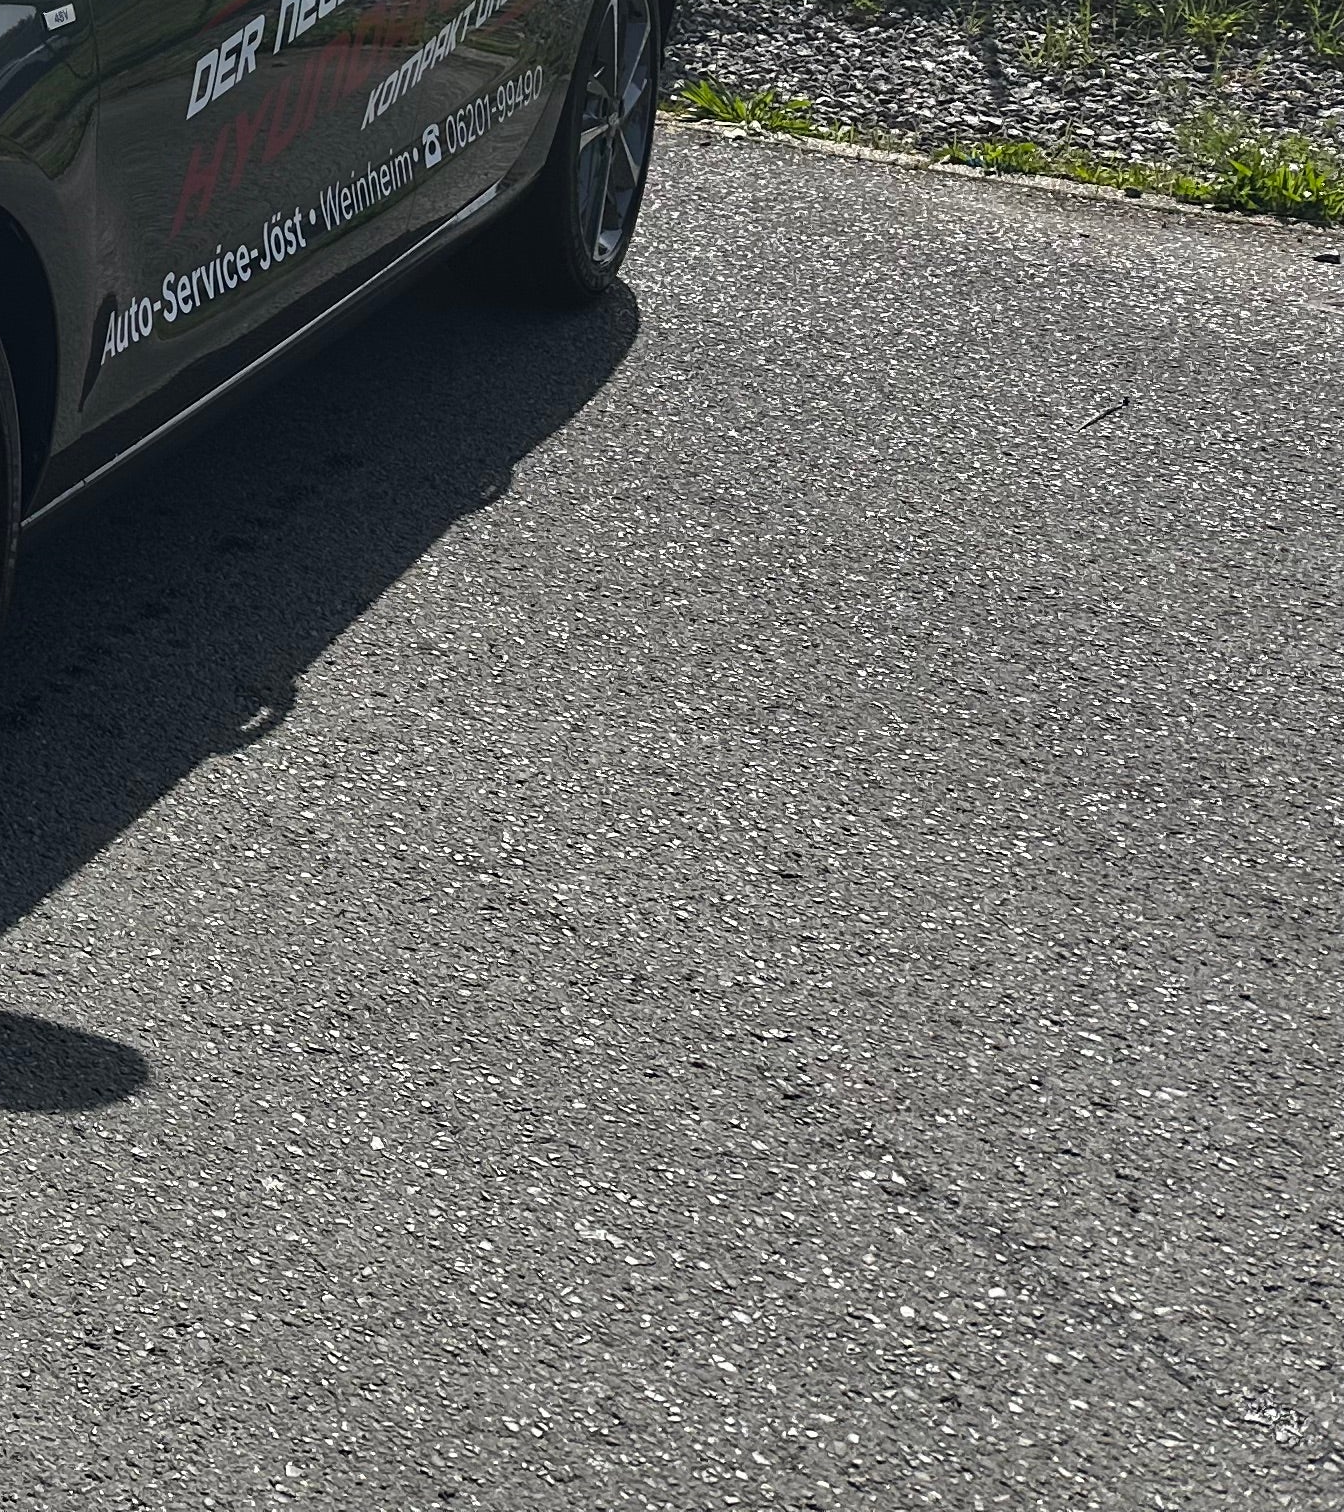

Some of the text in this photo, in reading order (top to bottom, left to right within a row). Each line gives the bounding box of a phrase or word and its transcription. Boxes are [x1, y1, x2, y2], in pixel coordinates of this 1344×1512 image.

[186, 13, 265, 120] DER
[361, 0, 476, 131] KOMPAKT
[101, 65, 543, 366] Auto-Service-Jöst Weinheim 06201-99490
